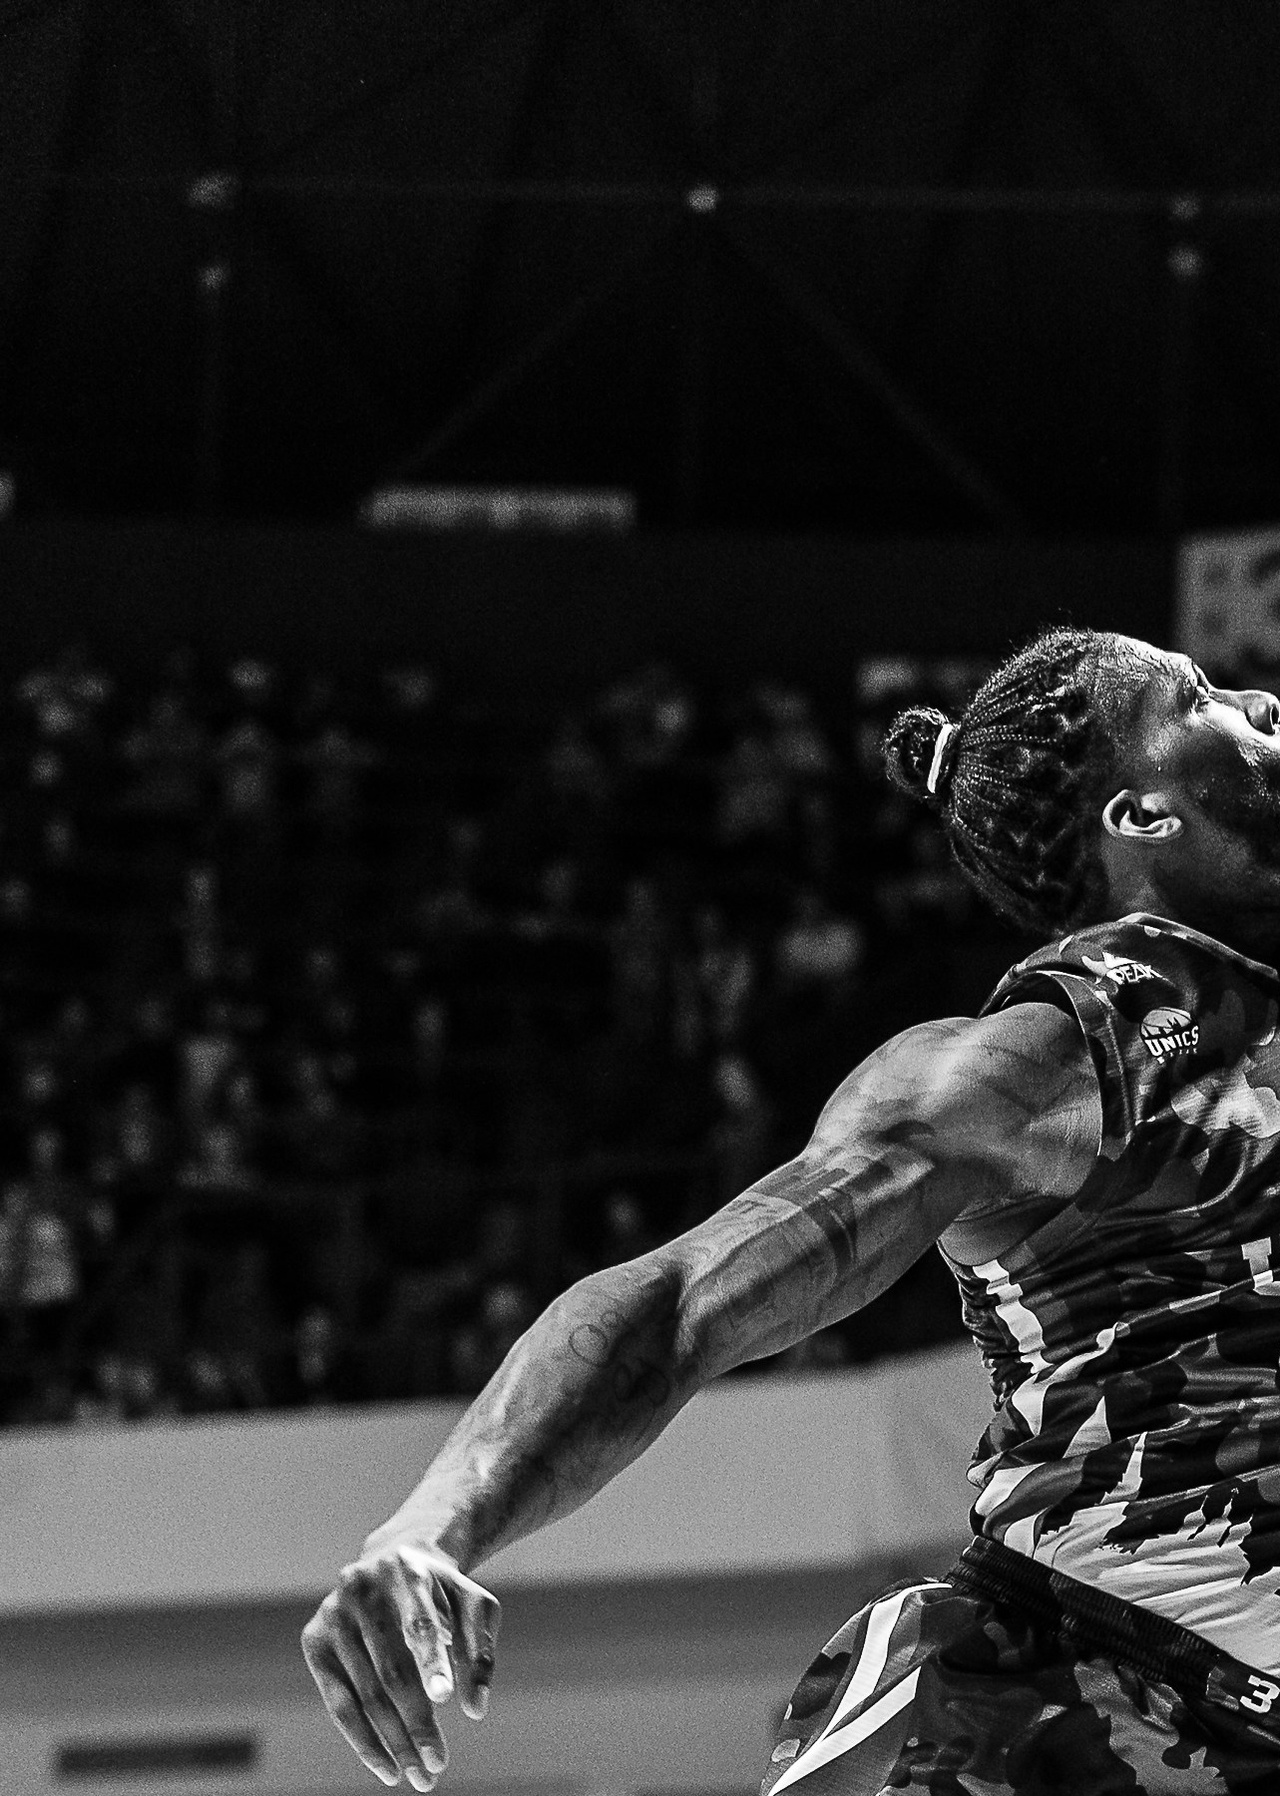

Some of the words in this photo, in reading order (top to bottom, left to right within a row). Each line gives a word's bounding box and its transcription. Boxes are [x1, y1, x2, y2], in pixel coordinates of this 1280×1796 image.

[1106, 962, 1164, 985] PEAK
[1144, 1025, 1199, 1057] UNICS
[1239, 1674, 1280, 1714] 3
